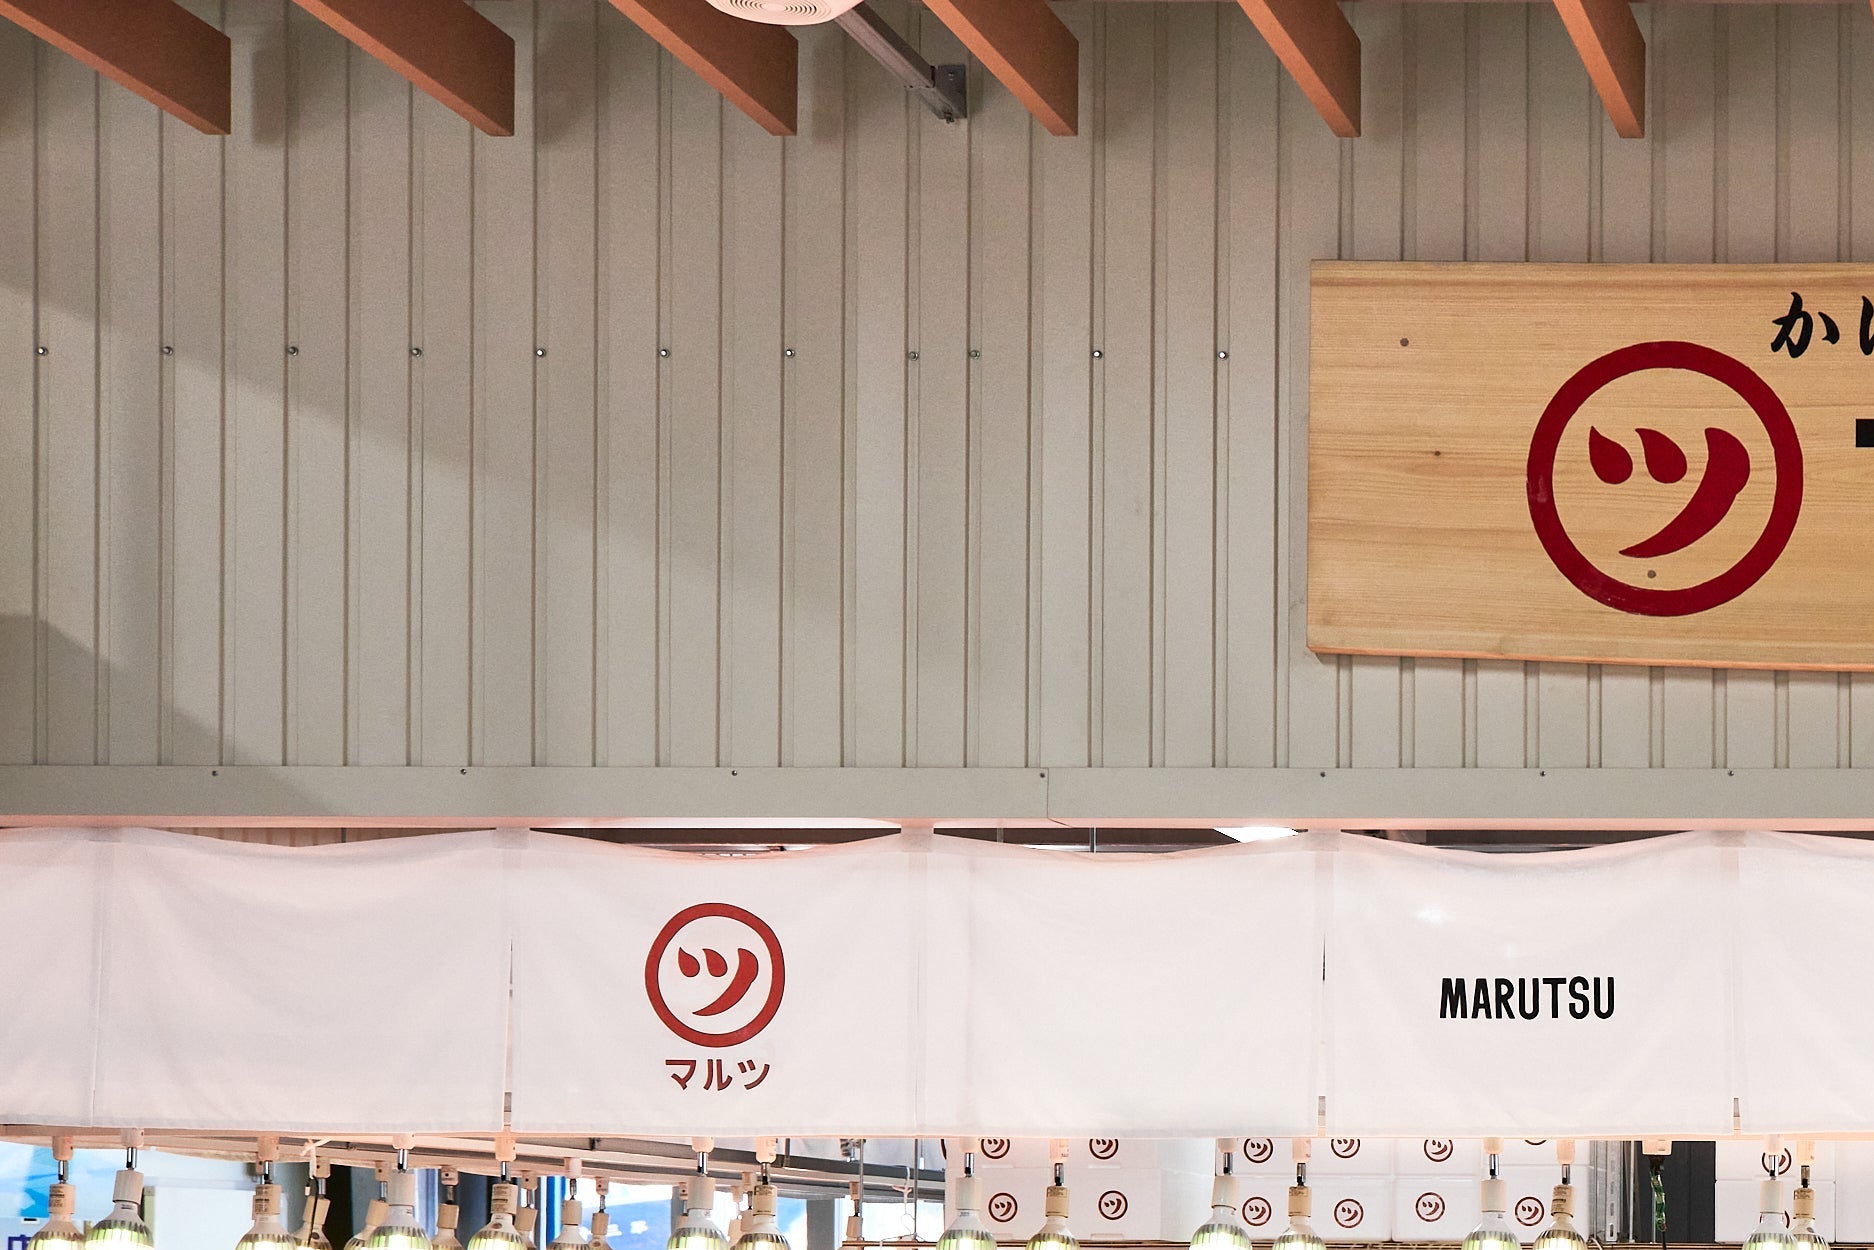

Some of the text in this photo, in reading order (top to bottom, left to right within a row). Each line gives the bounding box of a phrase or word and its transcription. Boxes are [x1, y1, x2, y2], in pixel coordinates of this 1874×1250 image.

[1439, 976, 1616, 1020] MARUTSU
[665, 1057, 771, 1092] マルツ
